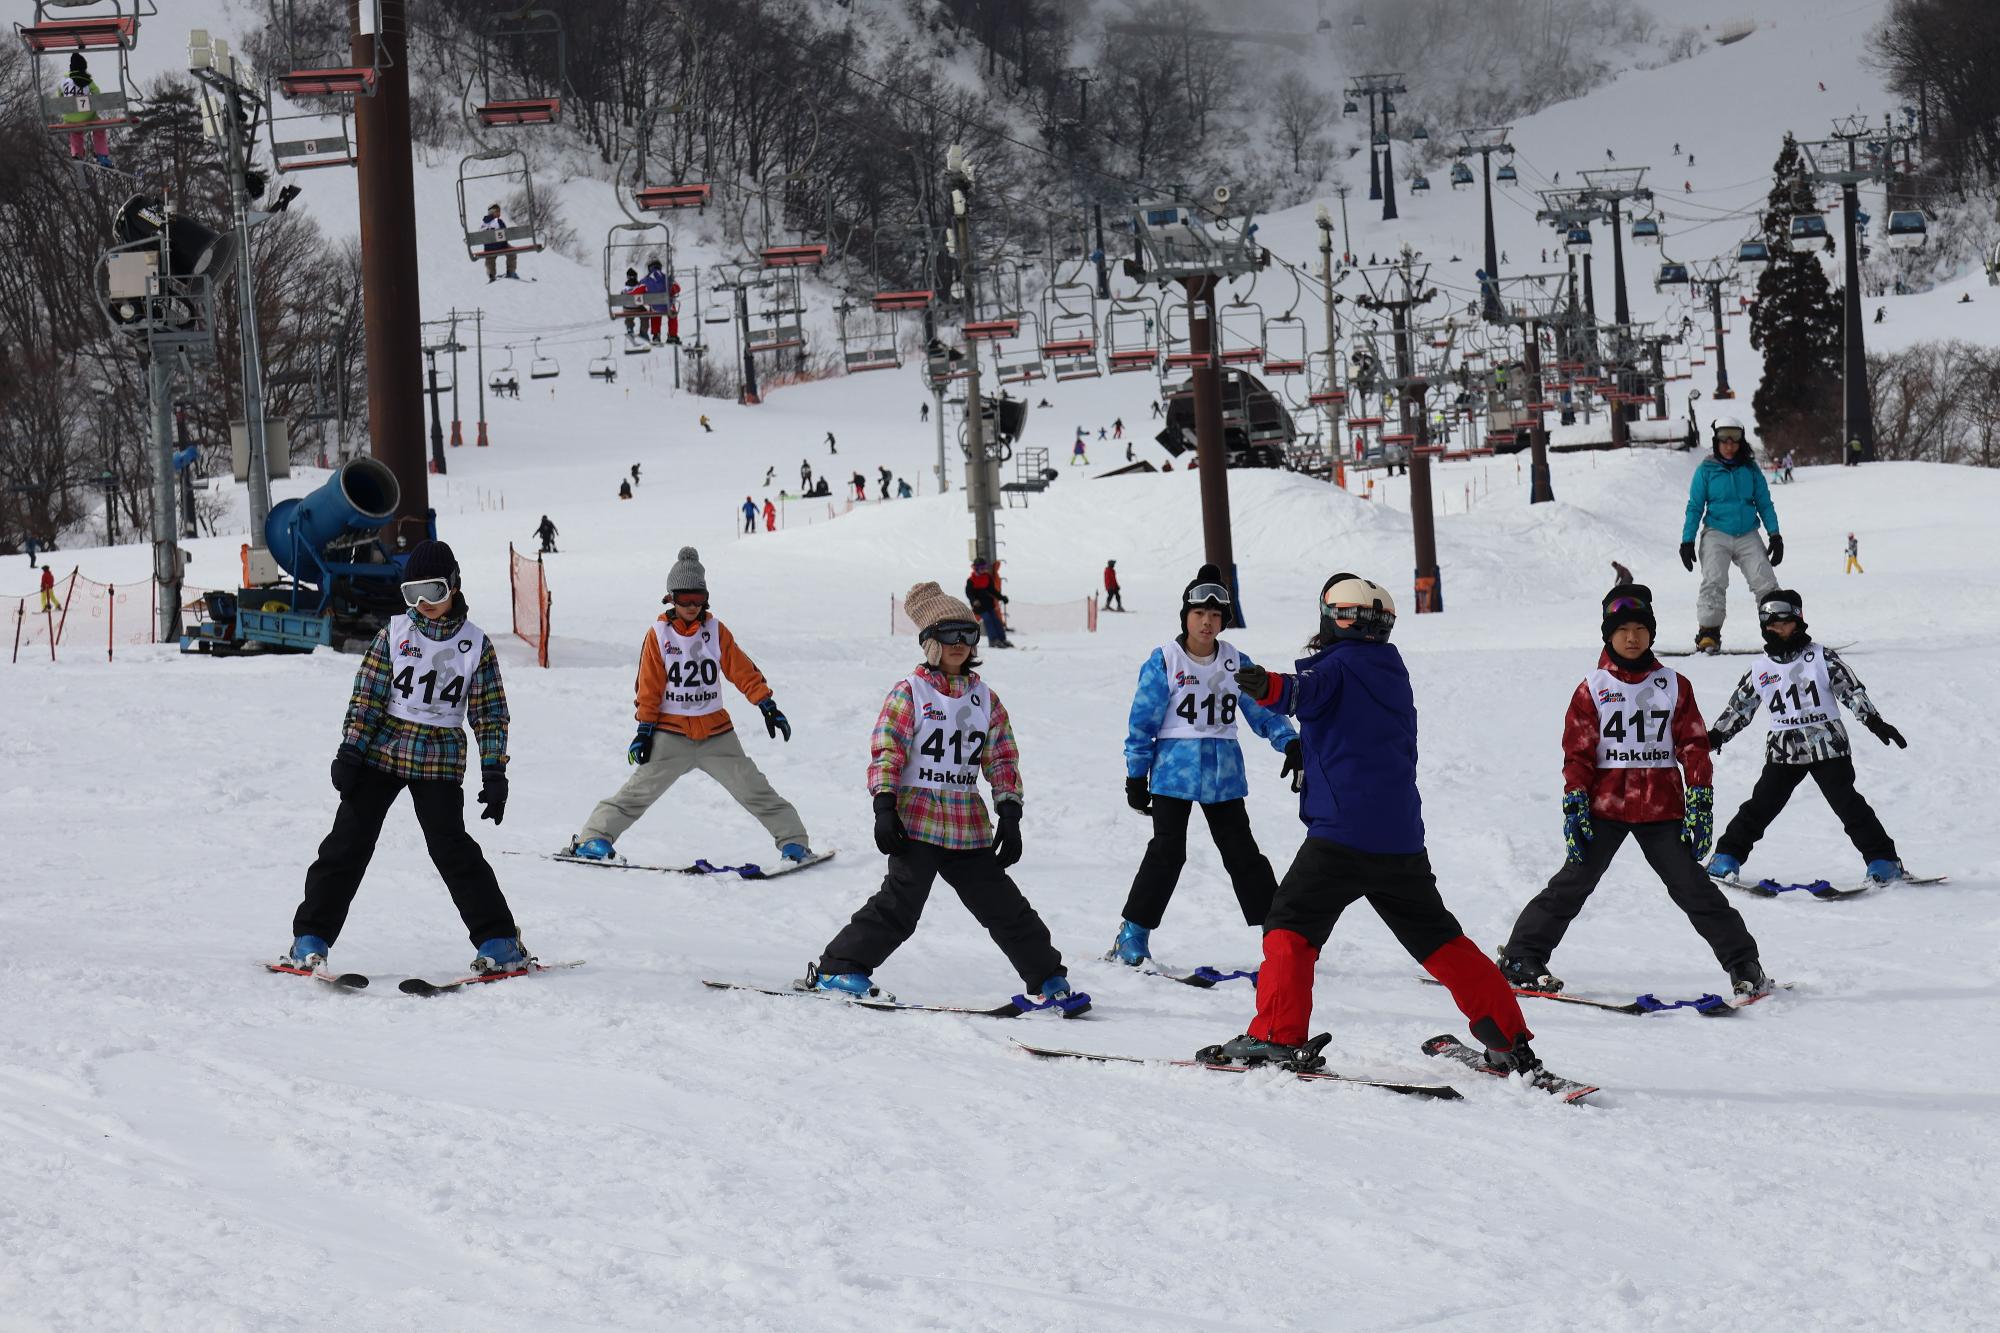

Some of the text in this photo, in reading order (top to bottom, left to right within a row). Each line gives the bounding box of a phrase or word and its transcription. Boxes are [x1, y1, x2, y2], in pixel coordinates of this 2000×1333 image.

[80, 100, 86, 108] 7
[308, 144, 314, 152] 6
[393, 666, 465, 708] 414
[668, 659, 717, 687] 420
[666, 690, 718, 702] Hakuba
[1176, 693, 1237, 725] 418
[1769, 680, 1820, 715] 411
[1603, 710, 1670, 743] 417
[1773, 712, 1828, 725] akuba
[921, 728, 986, 766] 412
[1605, 748, 1670, 761] Hakuba
